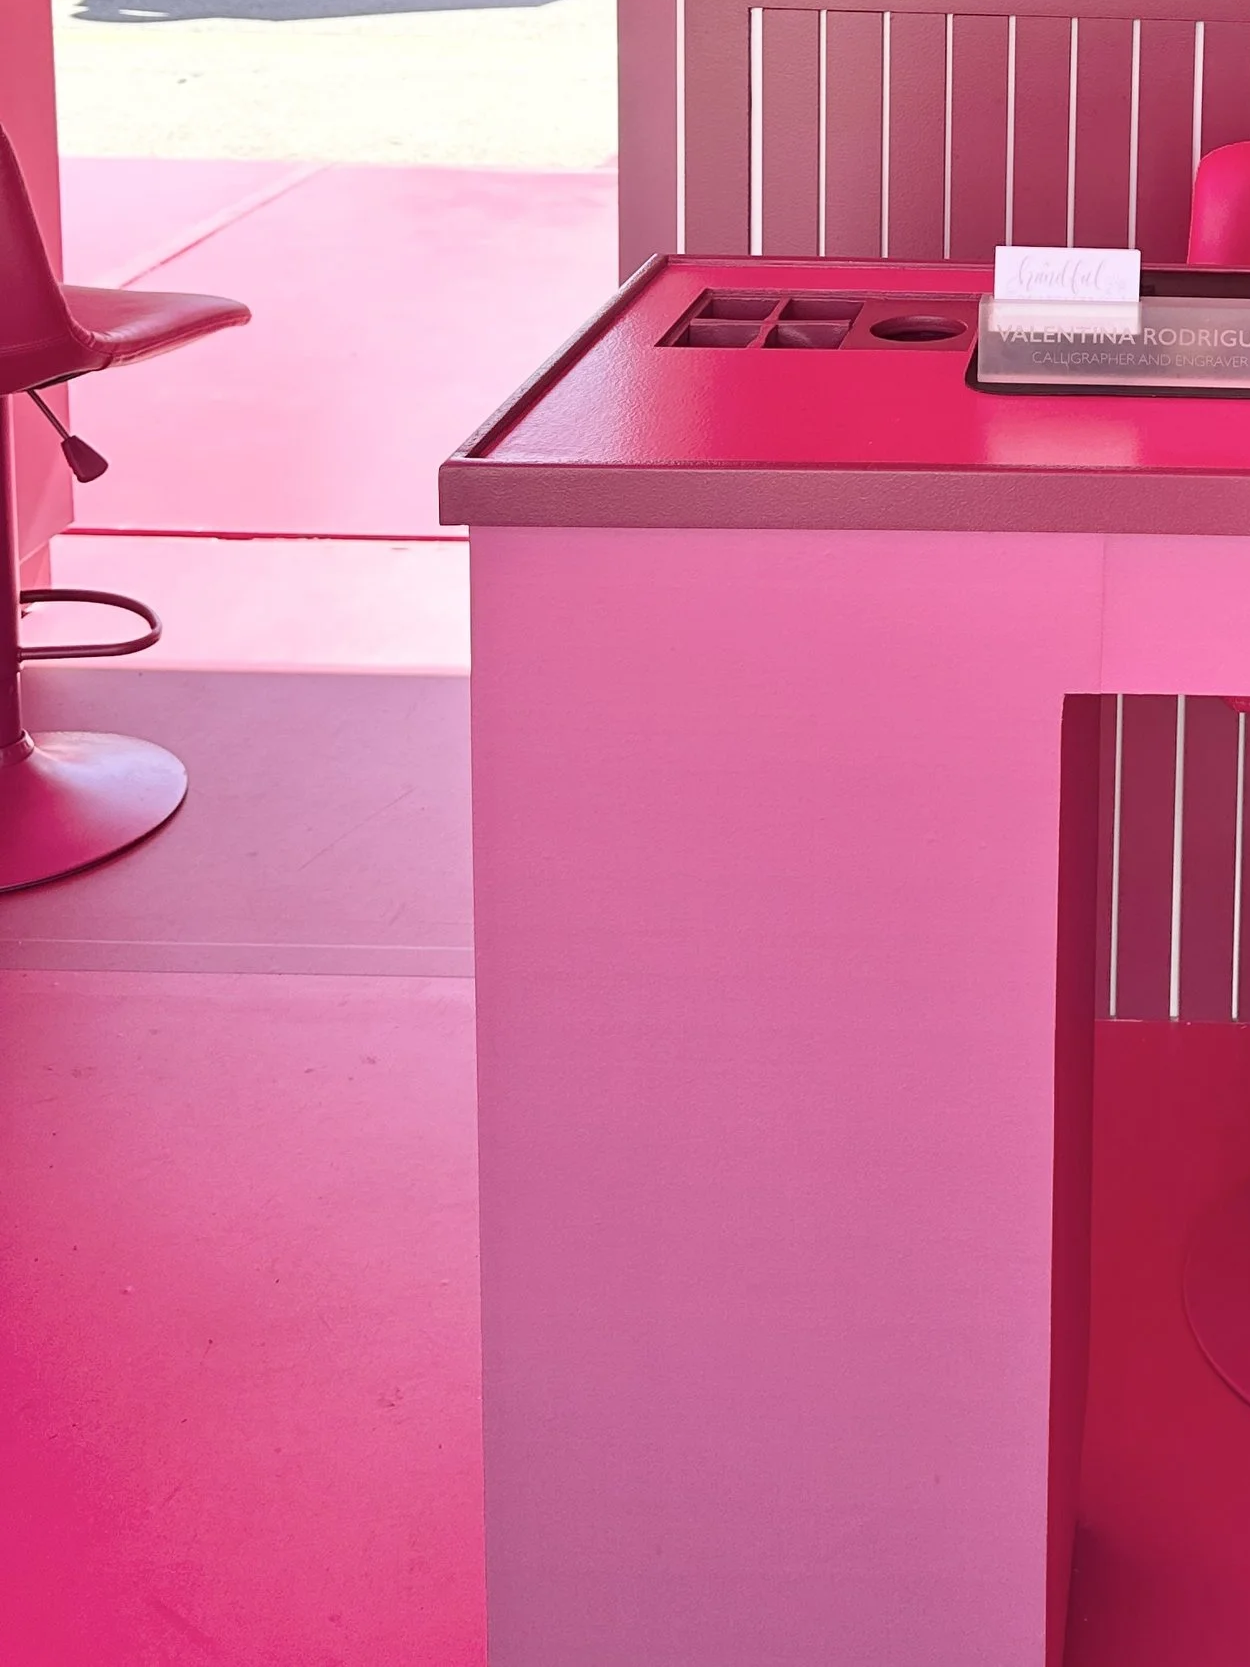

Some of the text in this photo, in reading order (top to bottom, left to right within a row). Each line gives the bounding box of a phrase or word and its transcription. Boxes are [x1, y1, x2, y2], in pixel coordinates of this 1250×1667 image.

[997, 324, 1136, 345] VALENTINA
[1032, 351, 1249, 369] CALLIGRAPHER AND ENGRAVER
